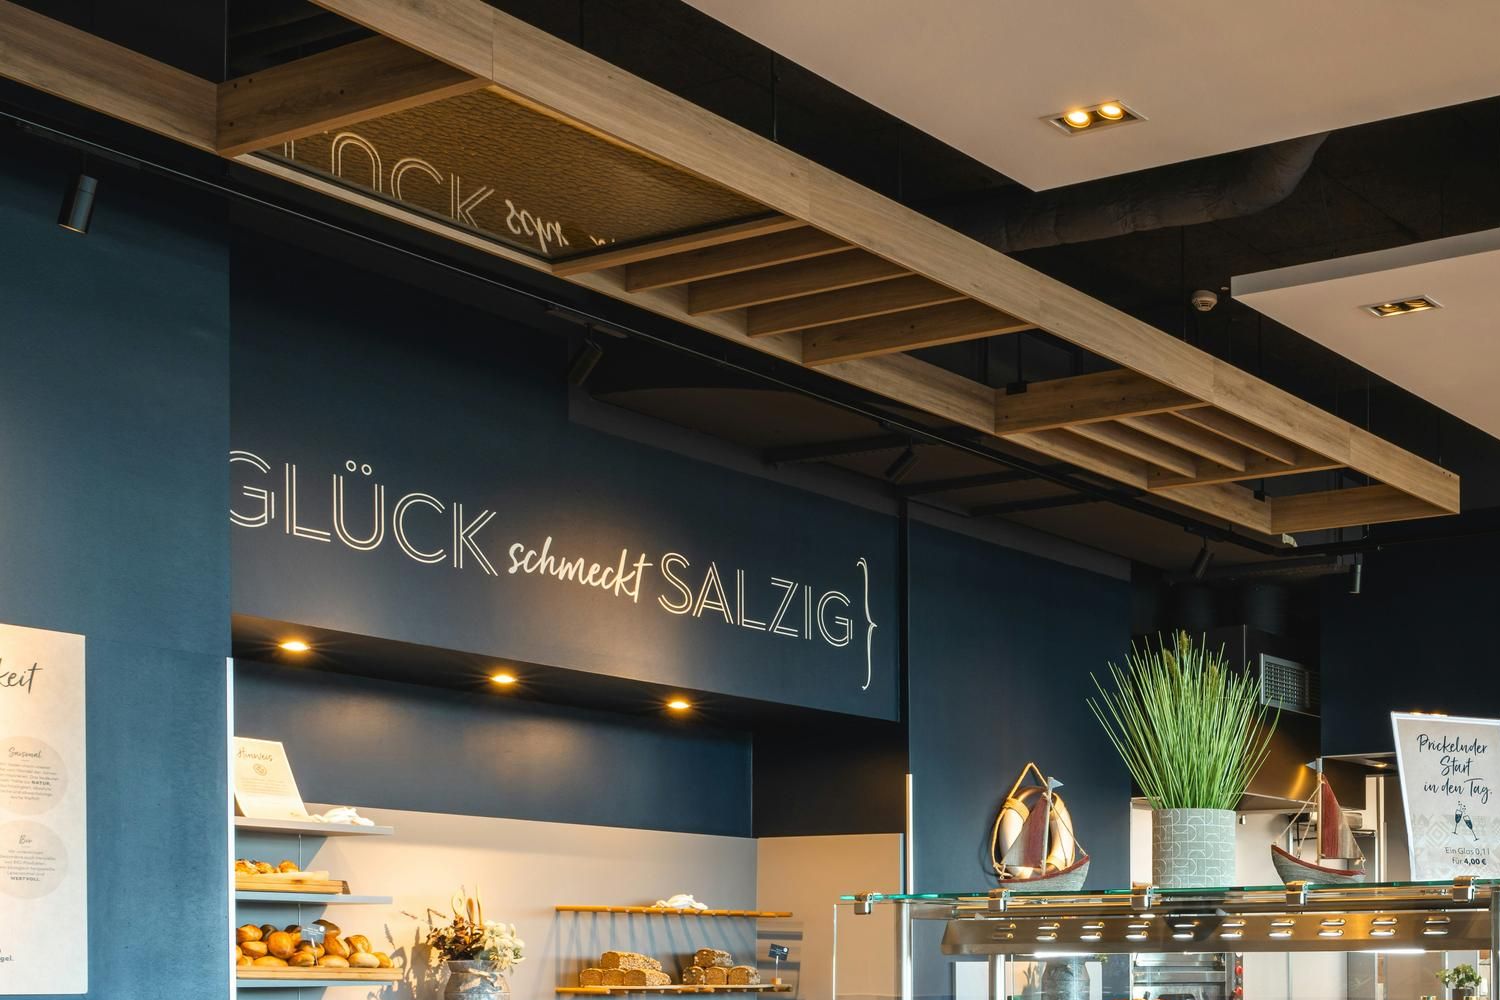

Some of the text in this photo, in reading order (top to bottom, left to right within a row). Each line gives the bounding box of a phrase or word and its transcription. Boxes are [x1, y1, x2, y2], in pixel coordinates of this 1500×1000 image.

[230, 450, 498, 577] GLÜCK
[508, 536, 653, 603] schmeckt
[658, 552, 853, 647] SALZIG
[1417, 734, 1488, 756] Prickelnder
[1440, 755, 1474, 776] Start
[1424, 782, 1439, 793] in
[1441, 778, 1464, 796] den
[1464, 858, 1481, 866] 4,00
